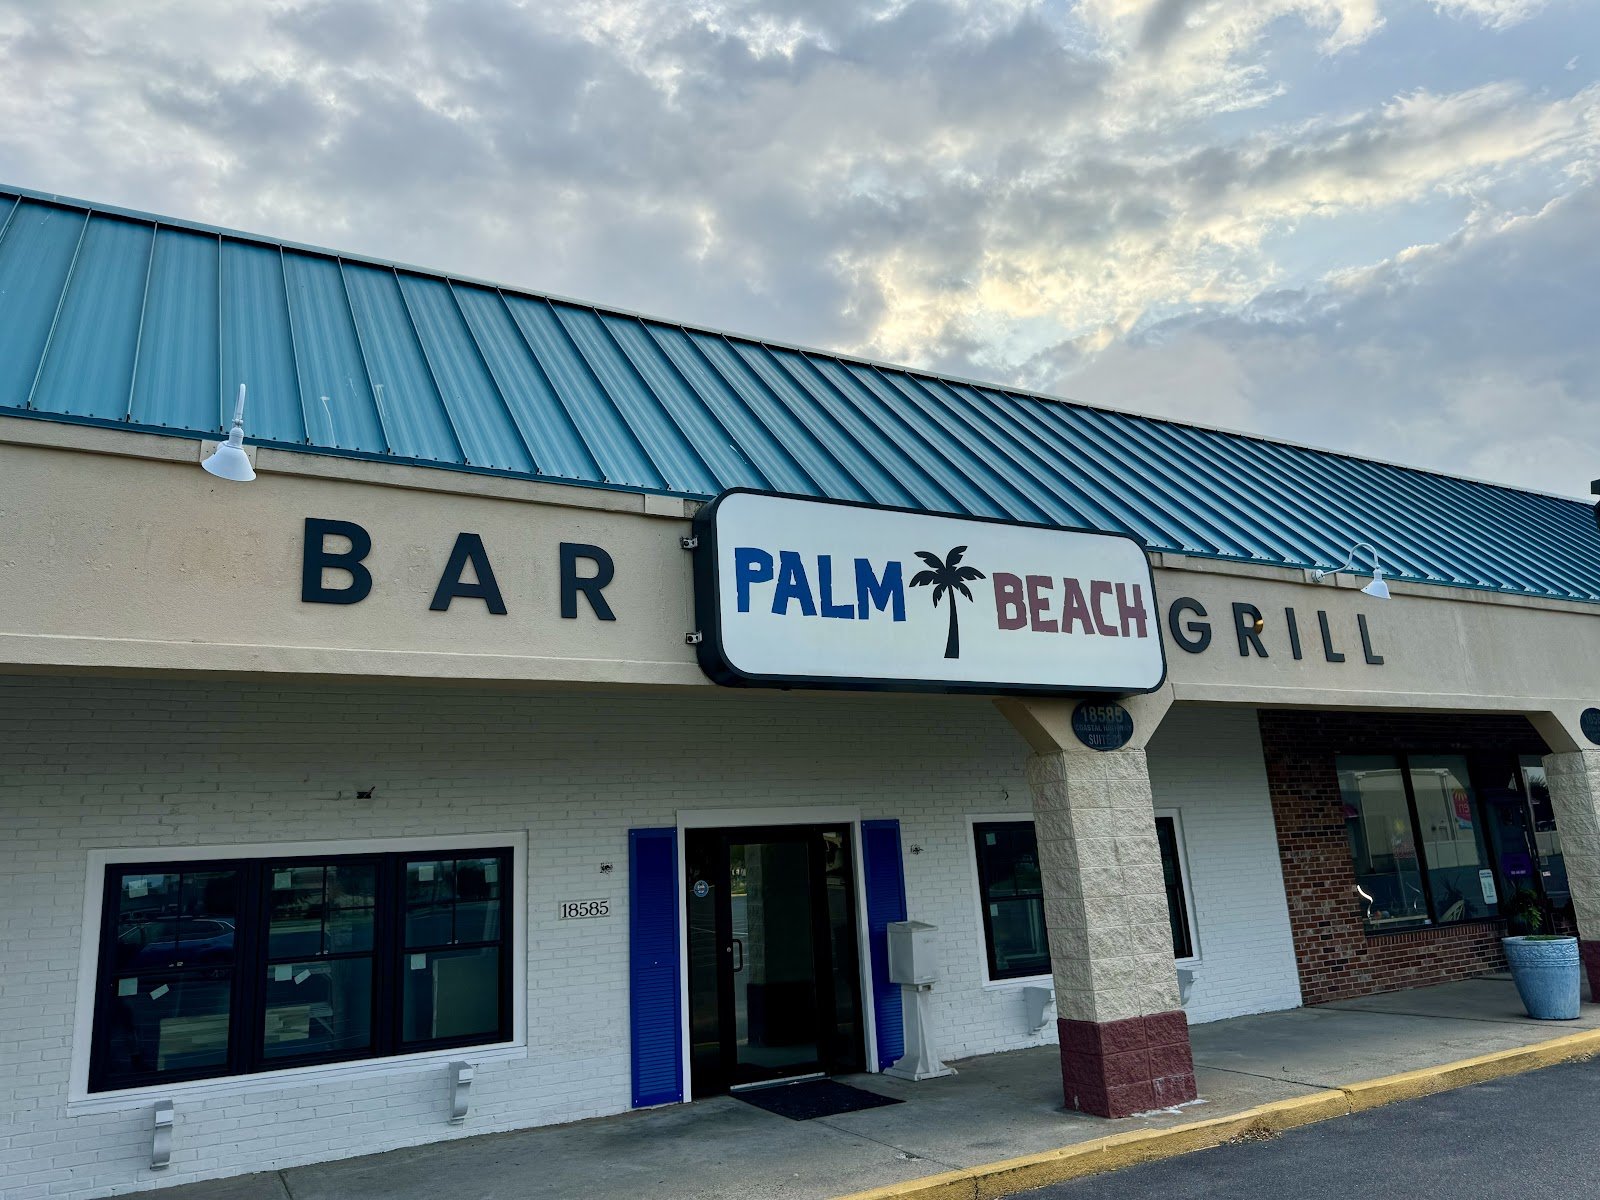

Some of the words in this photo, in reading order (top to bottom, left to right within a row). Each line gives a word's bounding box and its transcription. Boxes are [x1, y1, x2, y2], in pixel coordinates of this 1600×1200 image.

[301, 517, 617, 622] BAR
[734, 546, 907, 622] PALM
[992, 572, 1149, 639] BEACH
[1168, 596, 1385, 665] GRILL
[1081, 706, 1123, 722] 18585
[1088, 734, 1111, 745] SUITE
[562, 901, 608, 918] 18585
